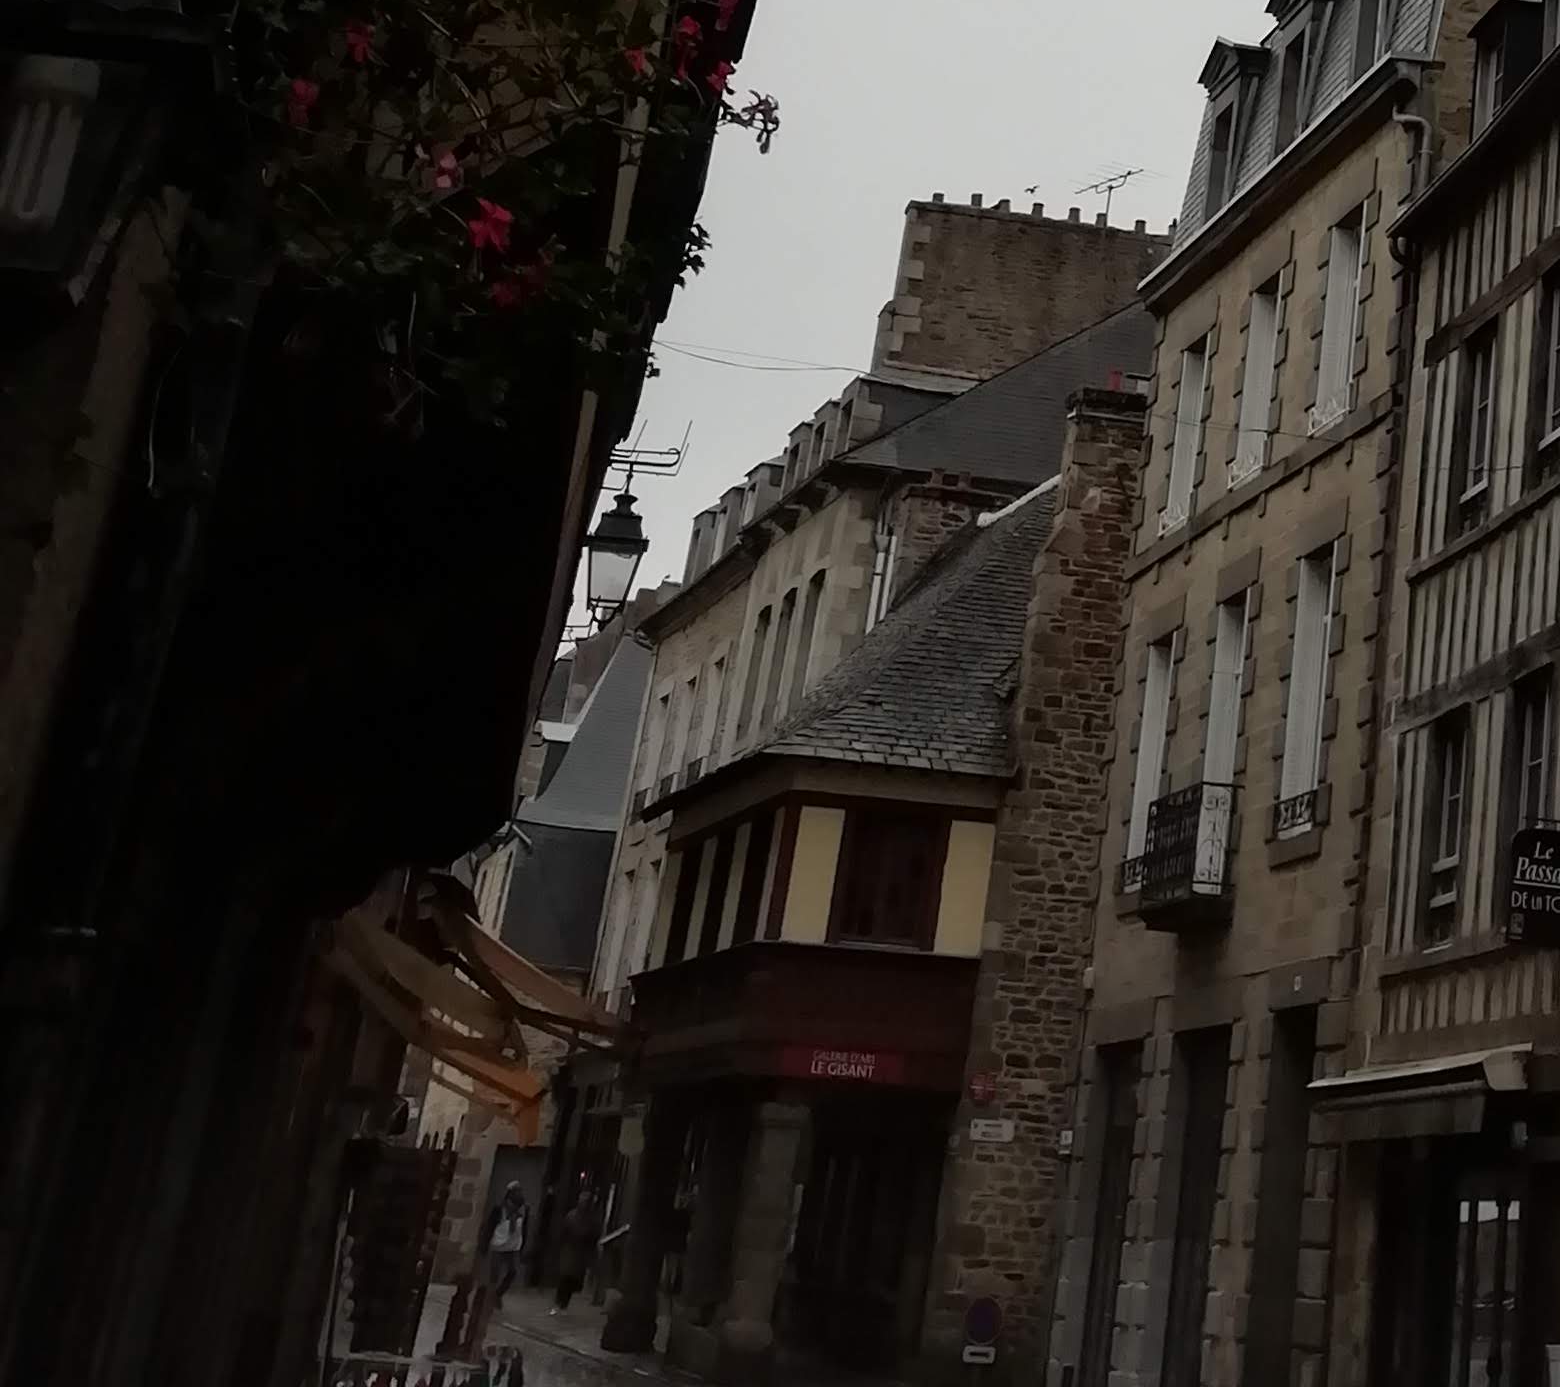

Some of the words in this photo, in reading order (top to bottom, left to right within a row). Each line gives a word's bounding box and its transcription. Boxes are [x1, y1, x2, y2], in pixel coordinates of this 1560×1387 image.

[1532, 840, 1555, 860] Le
[1511, 890, 1529, 910] DE
[810, 1060, 825, 1075] LE
[827, 1062, 876, 1079] GISANT
